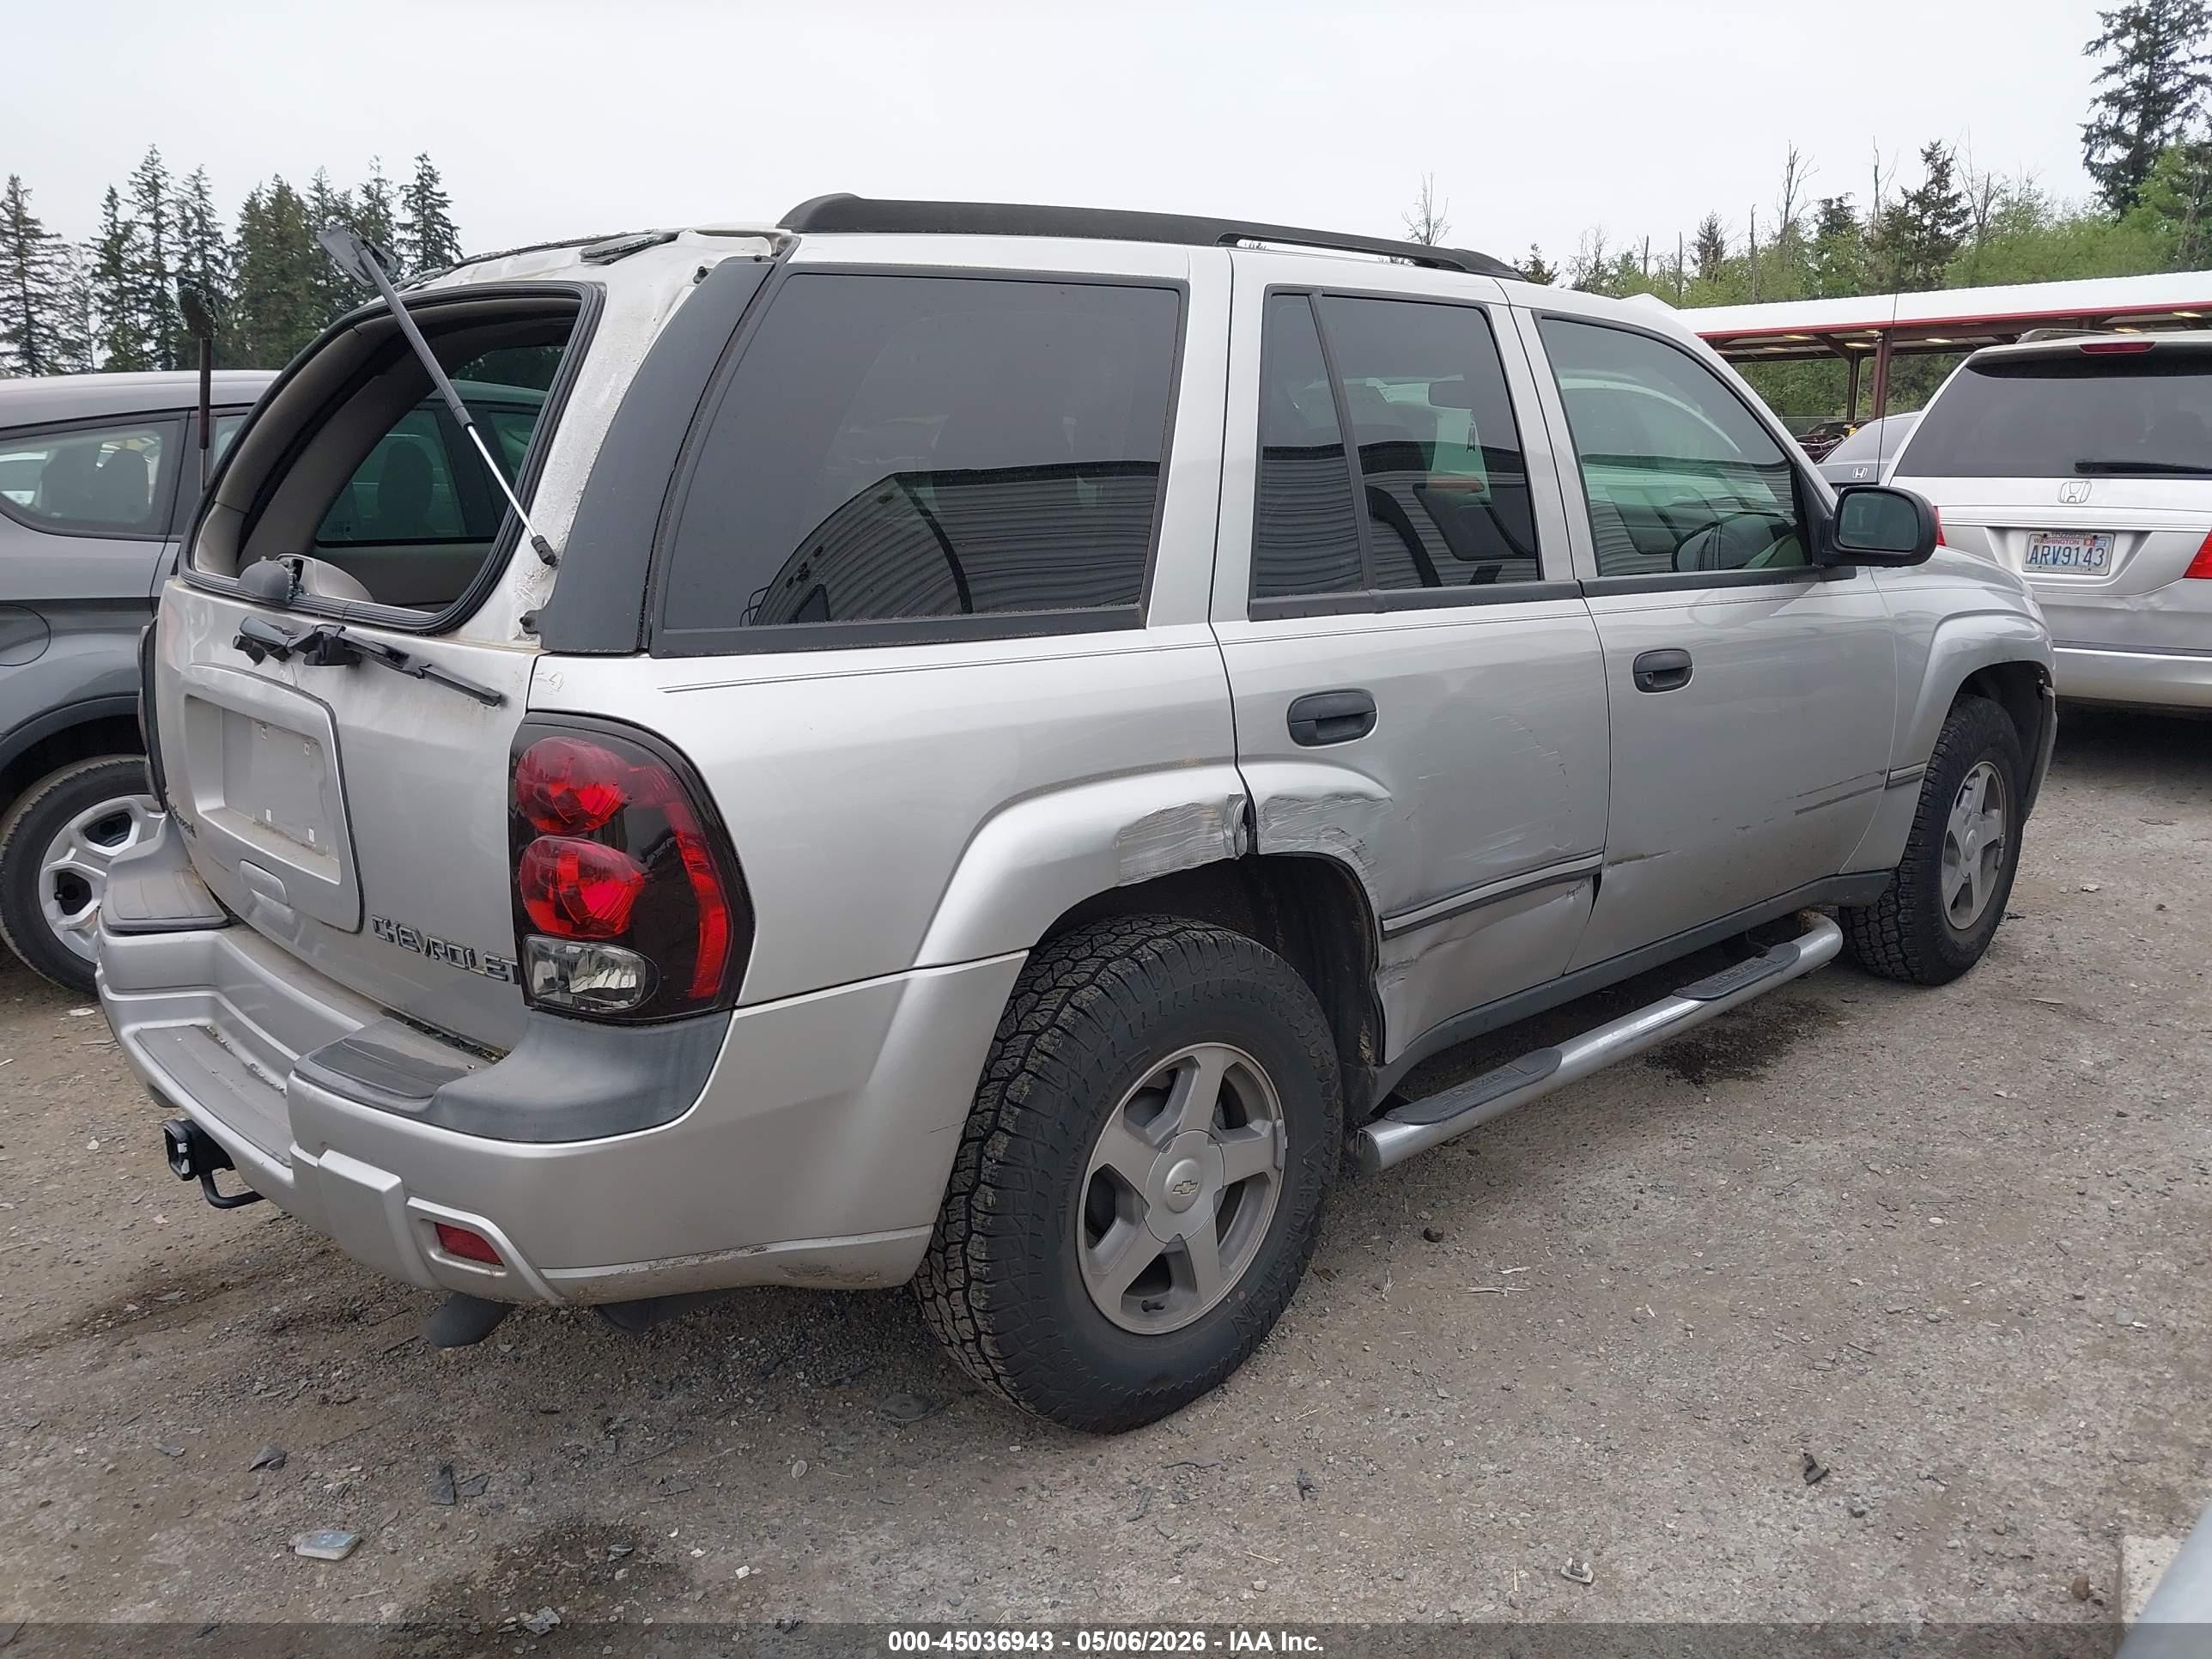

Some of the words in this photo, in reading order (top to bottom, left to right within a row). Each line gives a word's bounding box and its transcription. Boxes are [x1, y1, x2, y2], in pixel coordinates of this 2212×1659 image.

[2033, 538, 2080, 546] WASHINGTON
[2029, 545, 2105, 566] ARV9143
[371, 914, 521, 985] CHEVROLET
